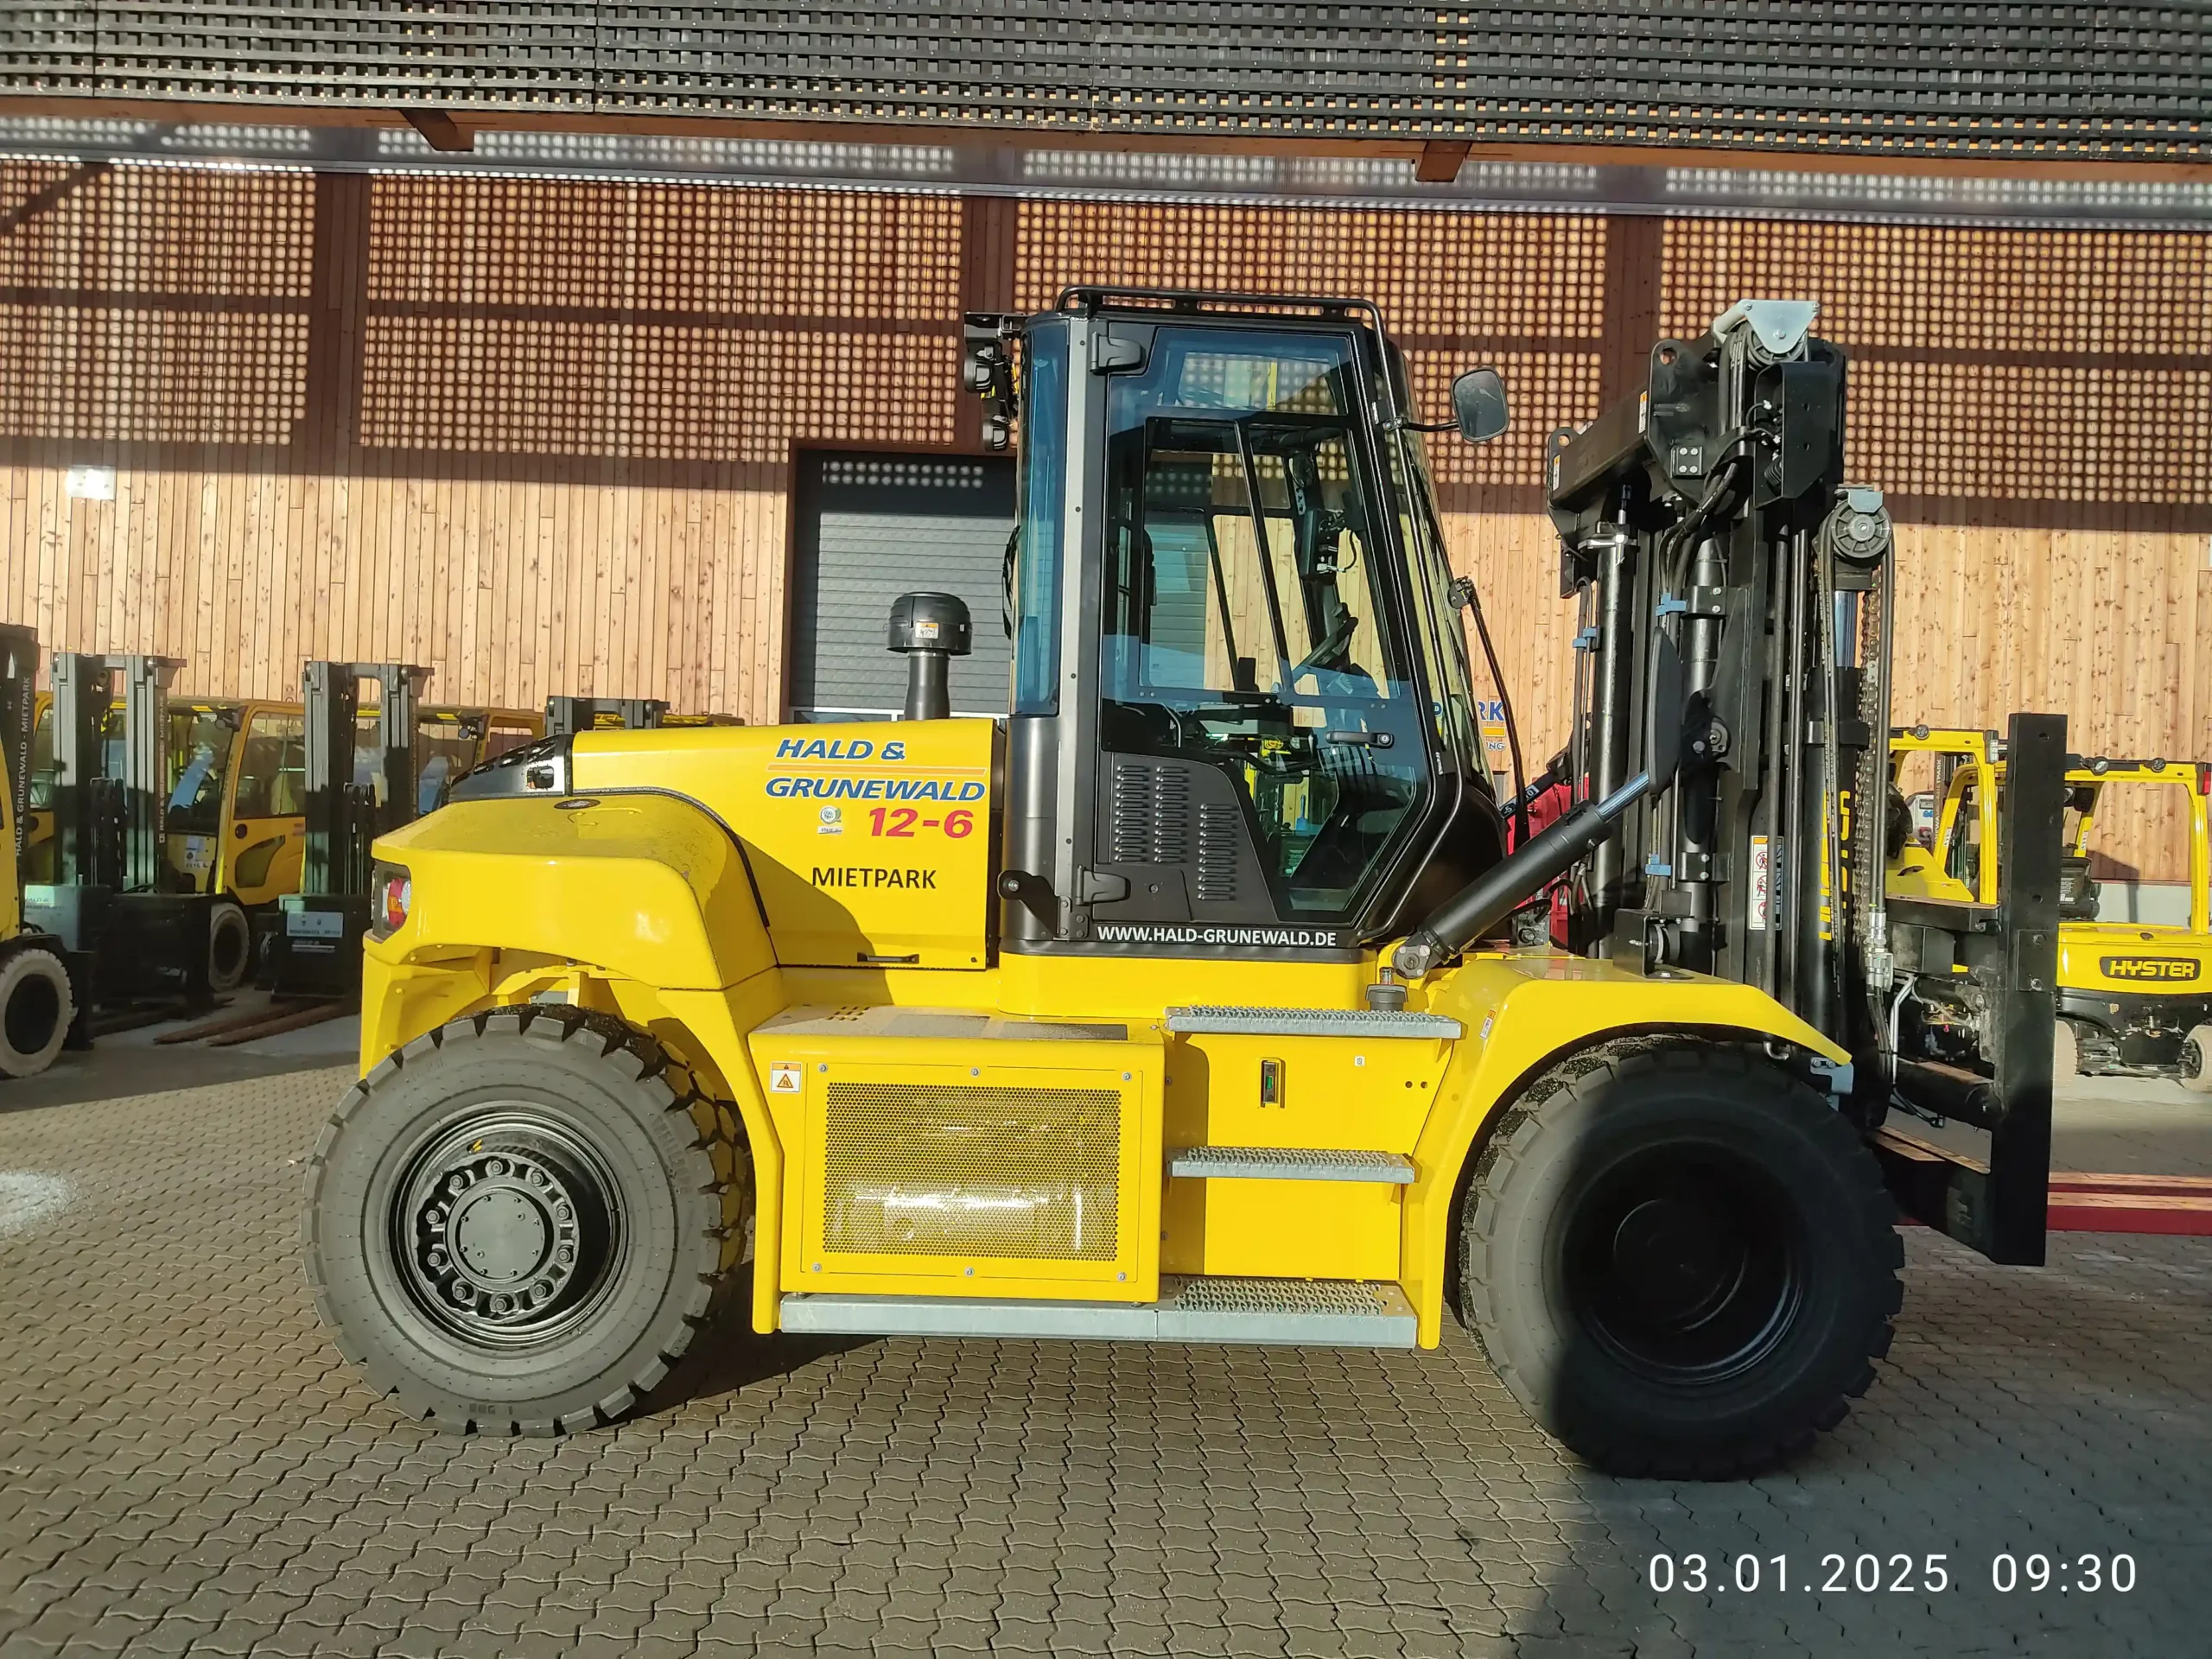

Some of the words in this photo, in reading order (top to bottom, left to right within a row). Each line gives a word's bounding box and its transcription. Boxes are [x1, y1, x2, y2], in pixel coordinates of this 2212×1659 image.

[21, 677, 30, 733] MIETPARK
[775, 739, 874, 760] HALD
[880, 741, 906, 760] &
[16, 741, 28, 813] GRUNEWALD
[766, 777, 987, 802] GRUNEWALD
[16, 815, 23, 825] &
[869, 807, 975, 839] 12-6
[812, 867, 937, 889] MIETPARK
[1097, 926, 1337, 947] WWW.HALD-GRUNEWALD.DE
[2109, 960, 2196, 978] HYSTER
